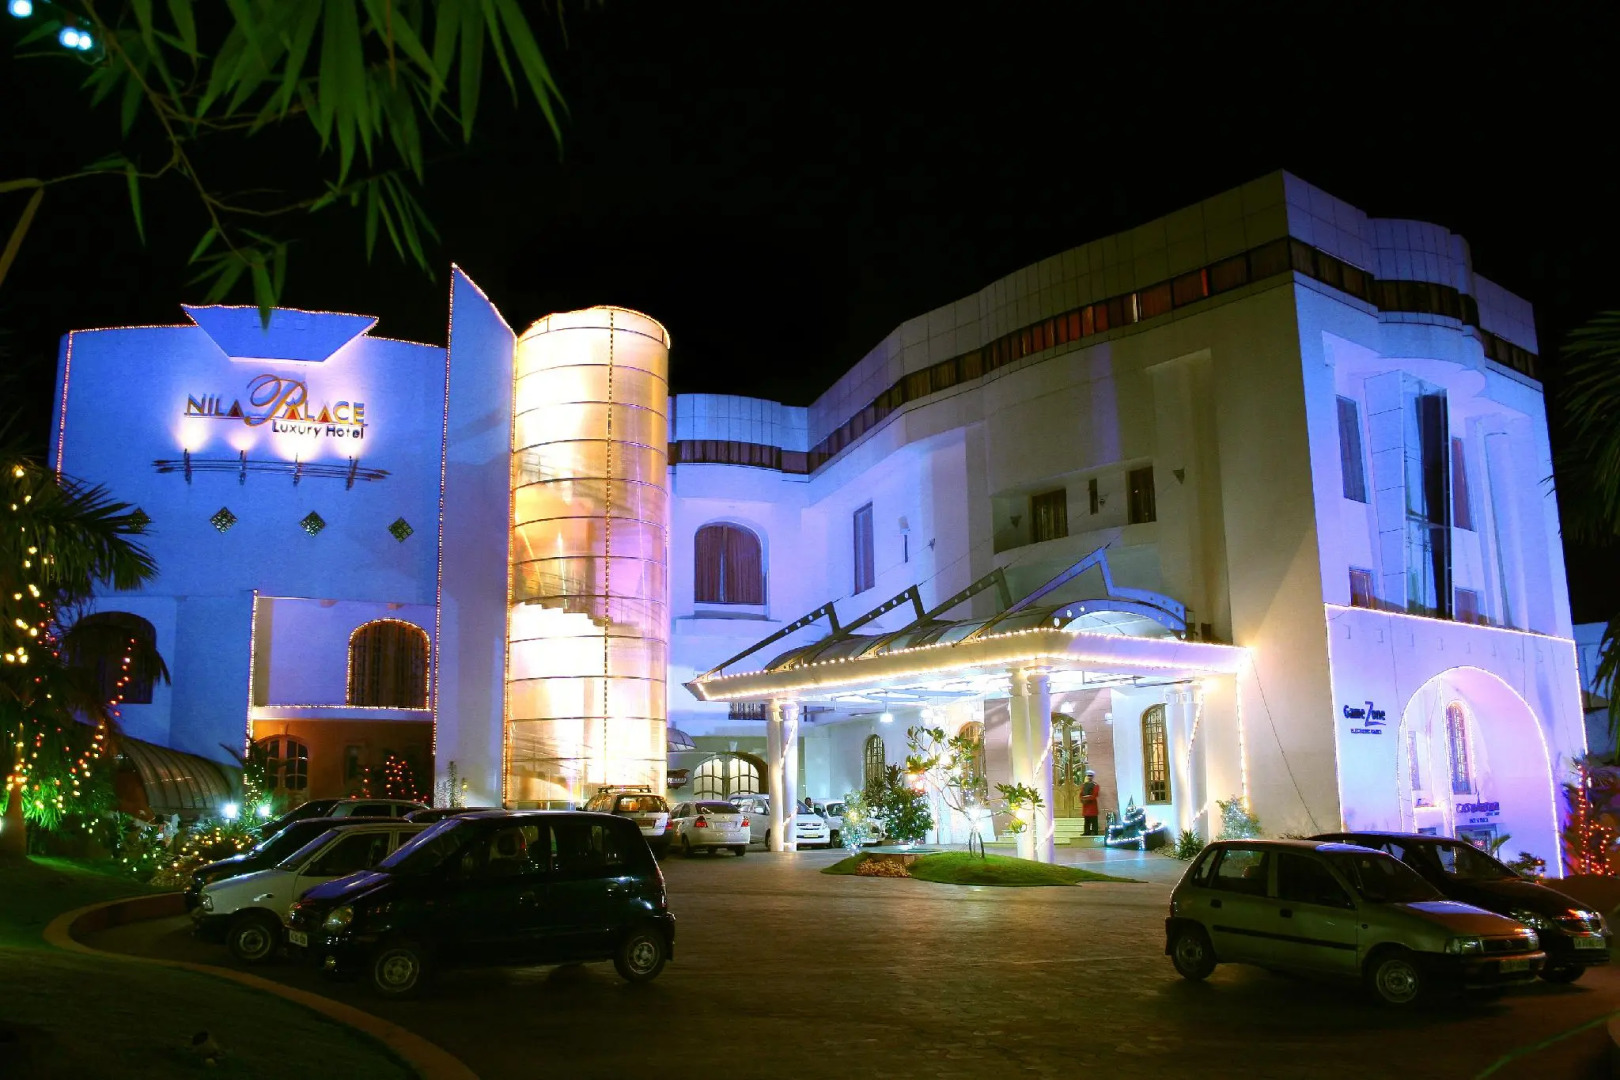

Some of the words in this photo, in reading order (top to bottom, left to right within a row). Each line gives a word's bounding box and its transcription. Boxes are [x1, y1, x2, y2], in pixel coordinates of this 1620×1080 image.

[186, 394, 244, 418] NILA
[244, 374, 366, 427] PALACE
[271, 419, 322, 439] Luxury
[325, 427, 364, 440] Hotel
